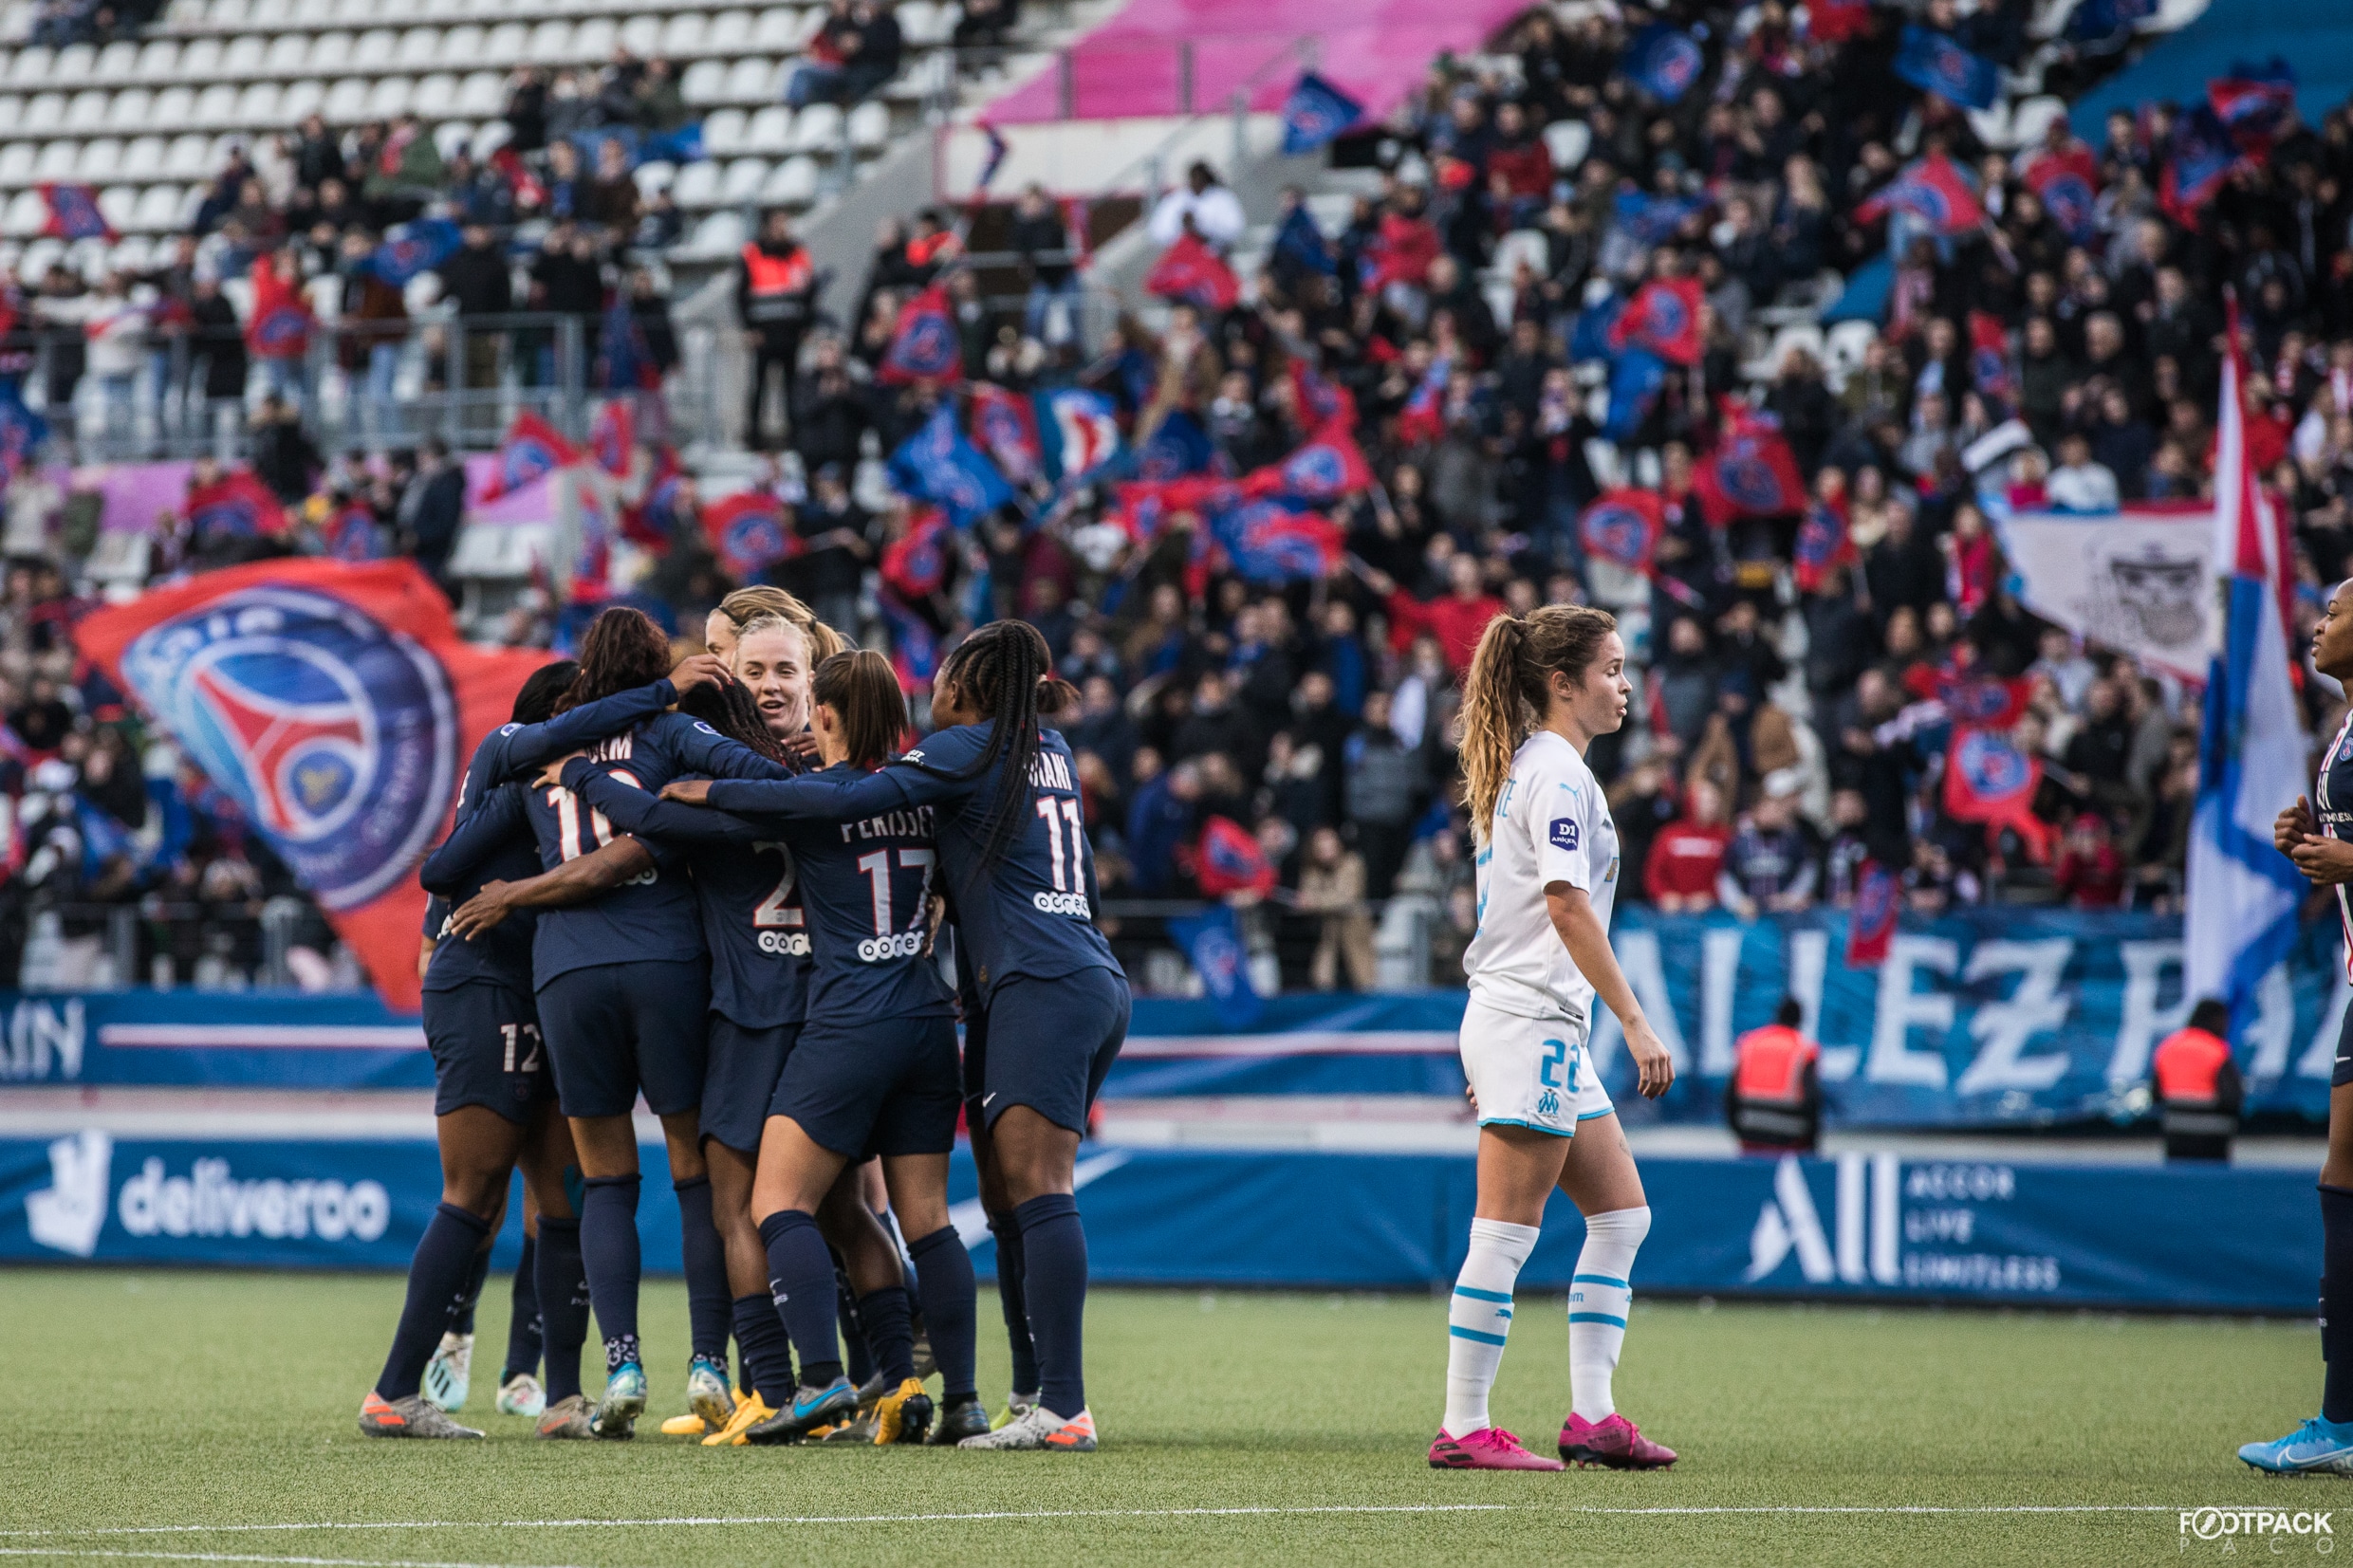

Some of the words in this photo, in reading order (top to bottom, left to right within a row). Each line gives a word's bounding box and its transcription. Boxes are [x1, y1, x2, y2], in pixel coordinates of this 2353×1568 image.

[1036, 795, 1085, 895] 11
[1559, 822, 1576, 837] D1
[752, 840, 805, 928] 2
[857, 847, 936, 937] 17
[1586, 929, 2074, 1095] ALLEZ
[500, 1024, 542, 1072] 12
[120, 1156, 390, 1242] deliveroo
[1906, 1164, 2015, 1201] ACCOR
[1905, 1207, 1974, 1244] LIVE
[1904, 1251, 2060, 1291] LIMITLESS
